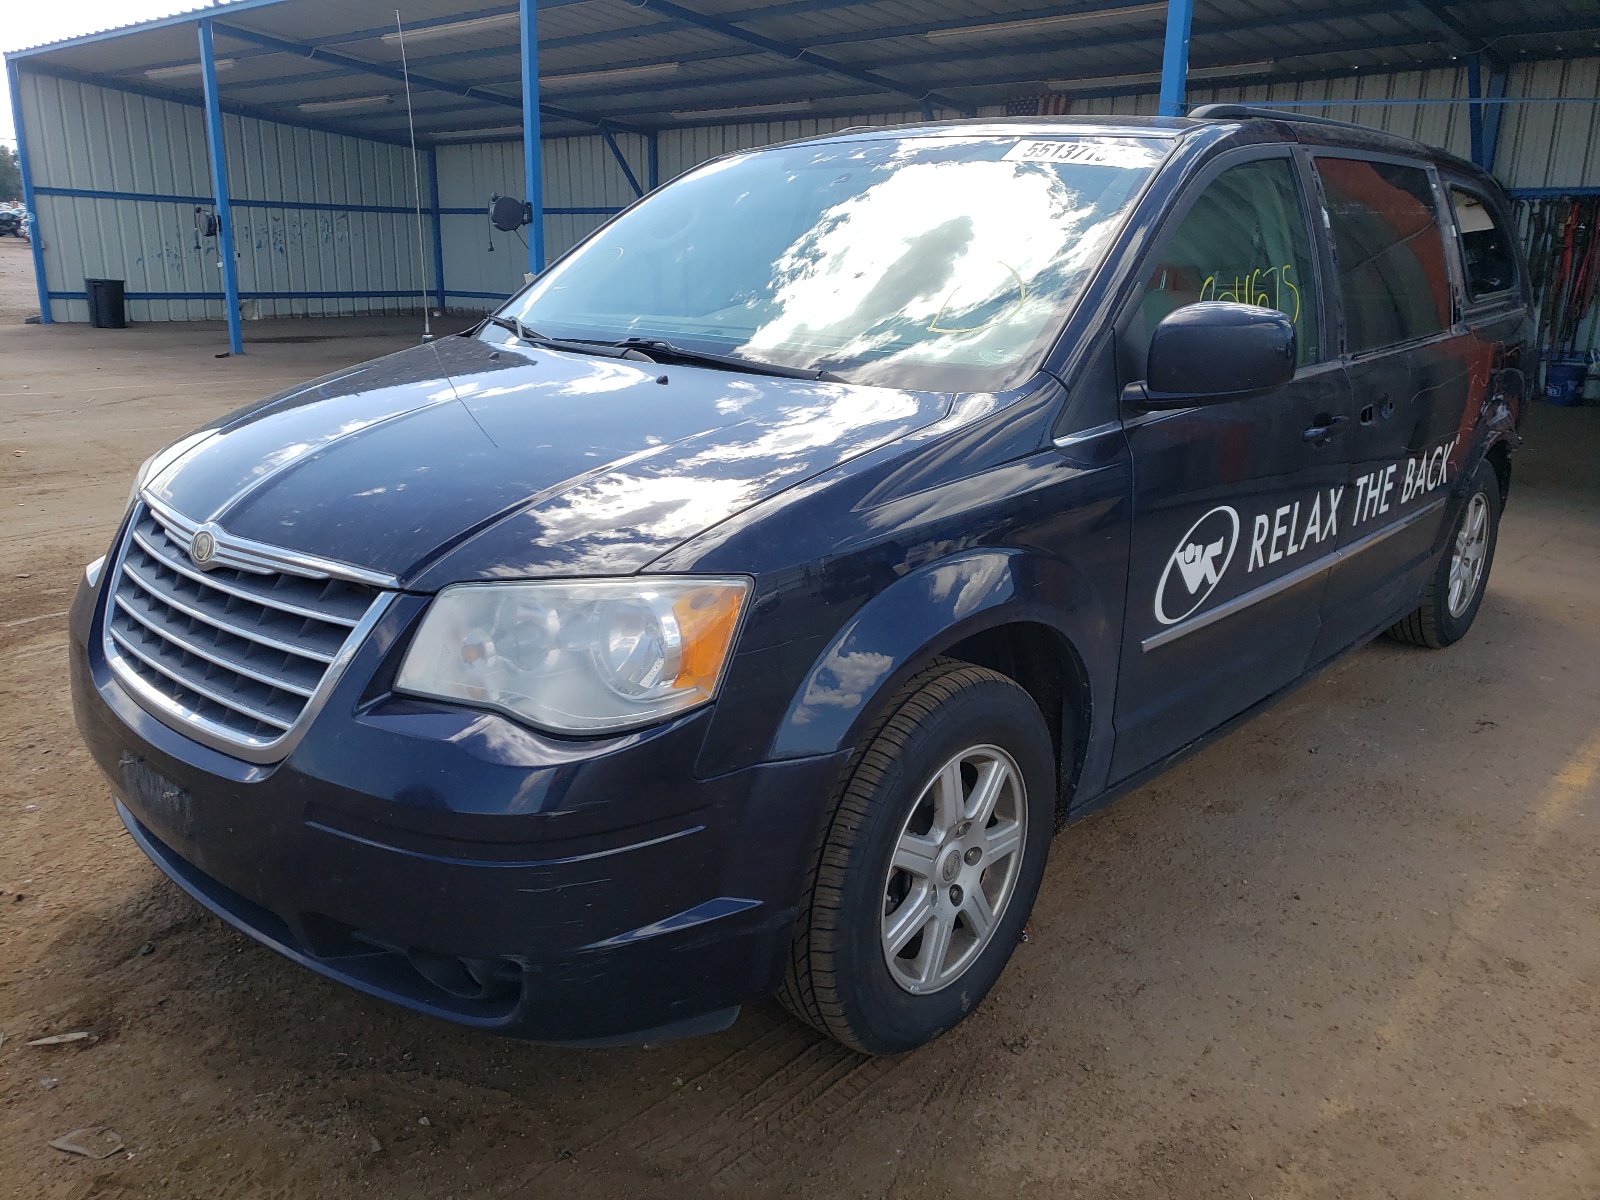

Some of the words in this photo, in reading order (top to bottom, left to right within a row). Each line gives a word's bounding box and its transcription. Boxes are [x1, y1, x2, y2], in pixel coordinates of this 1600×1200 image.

[1248, 485, 1344, 572] RELAX
[1352, 464, 1396, 526] THE
[1401, 441, 1455, 504] BACK
